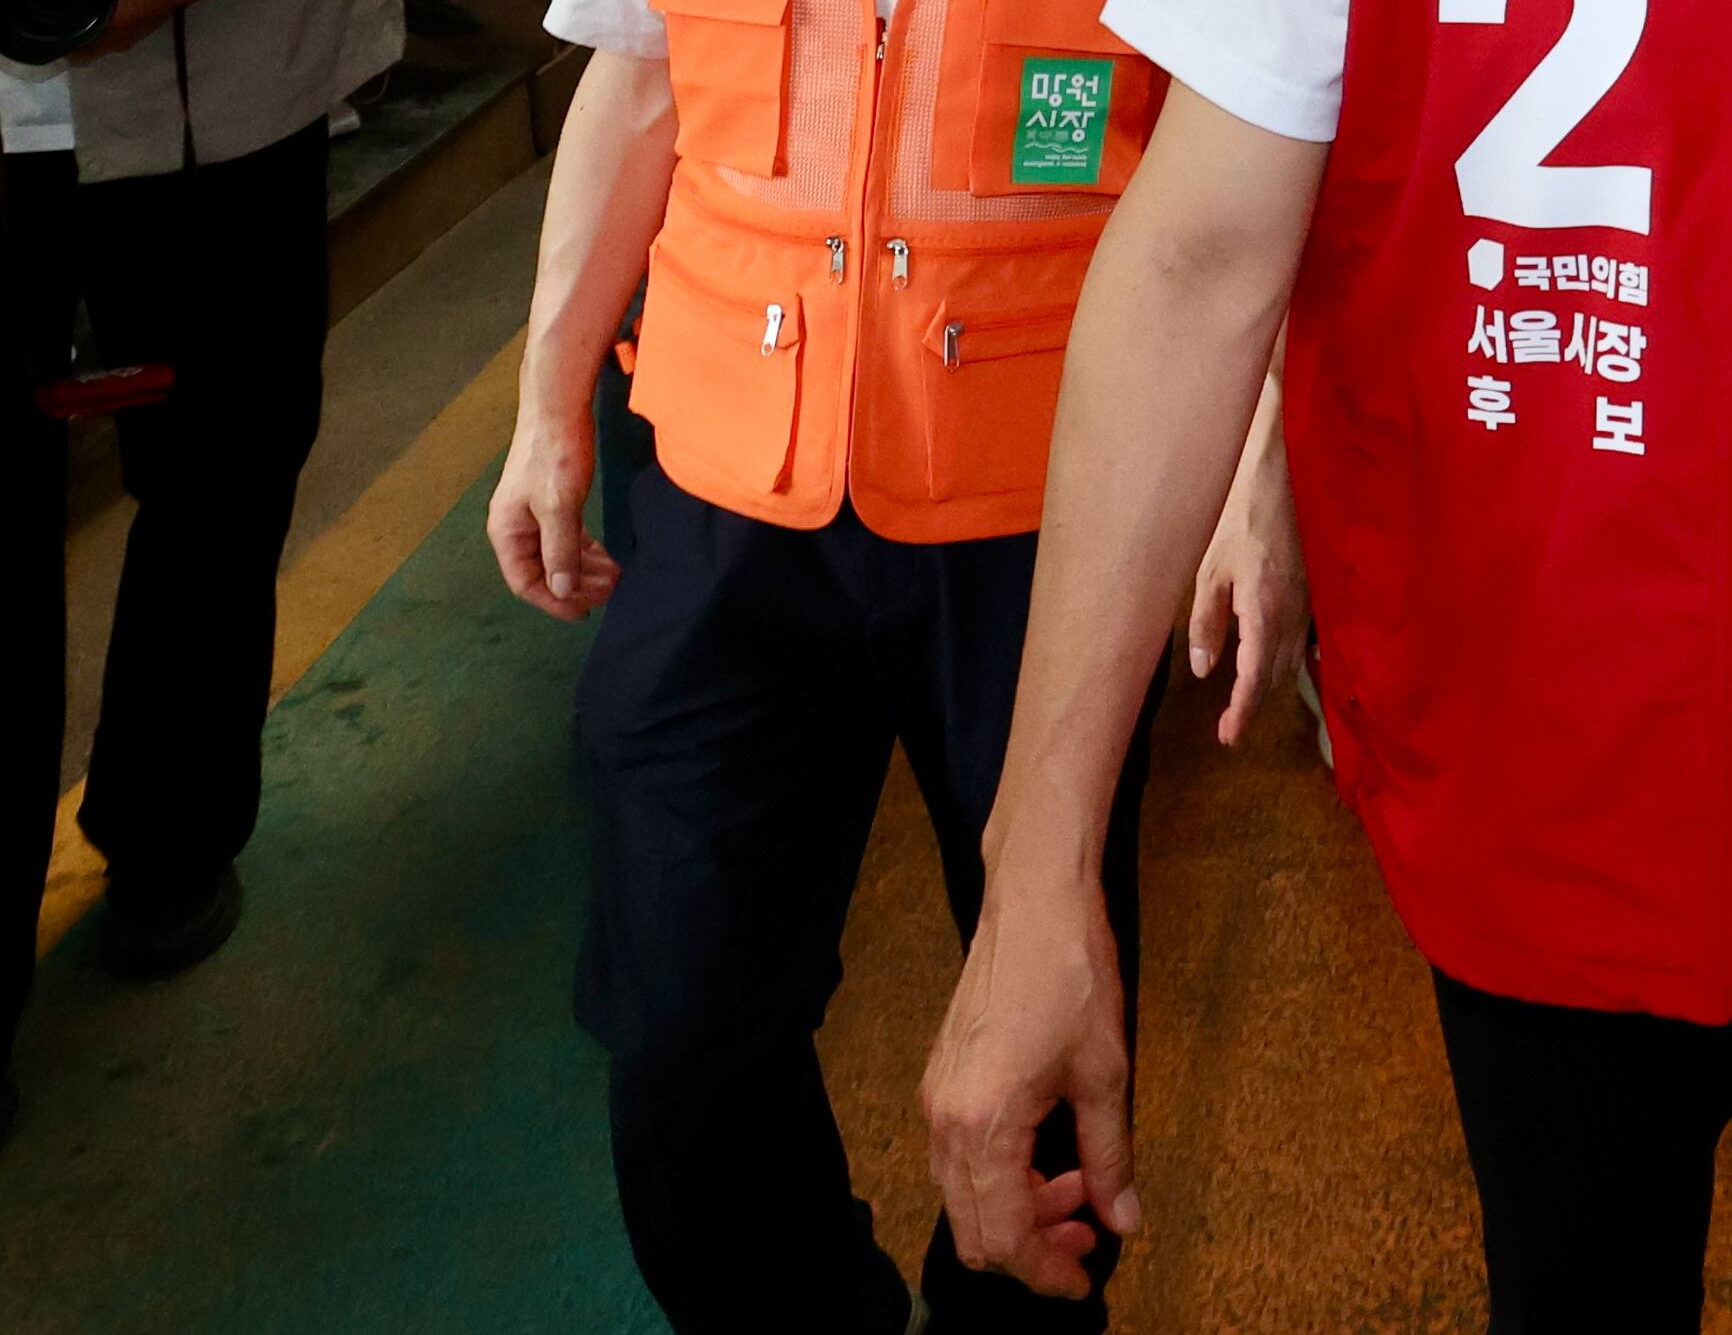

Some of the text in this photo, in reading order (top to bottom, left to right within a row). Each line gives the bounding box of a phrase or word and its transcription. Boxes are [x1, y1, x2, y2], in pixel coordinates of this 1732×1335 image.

[1031, 73, 1099, 108] 망원
[1025, 109, 1095, 143] 시장
[1513, 254, 1649, 307] 국민의힘
[1467, 304, 1648, 384] 서울시장
